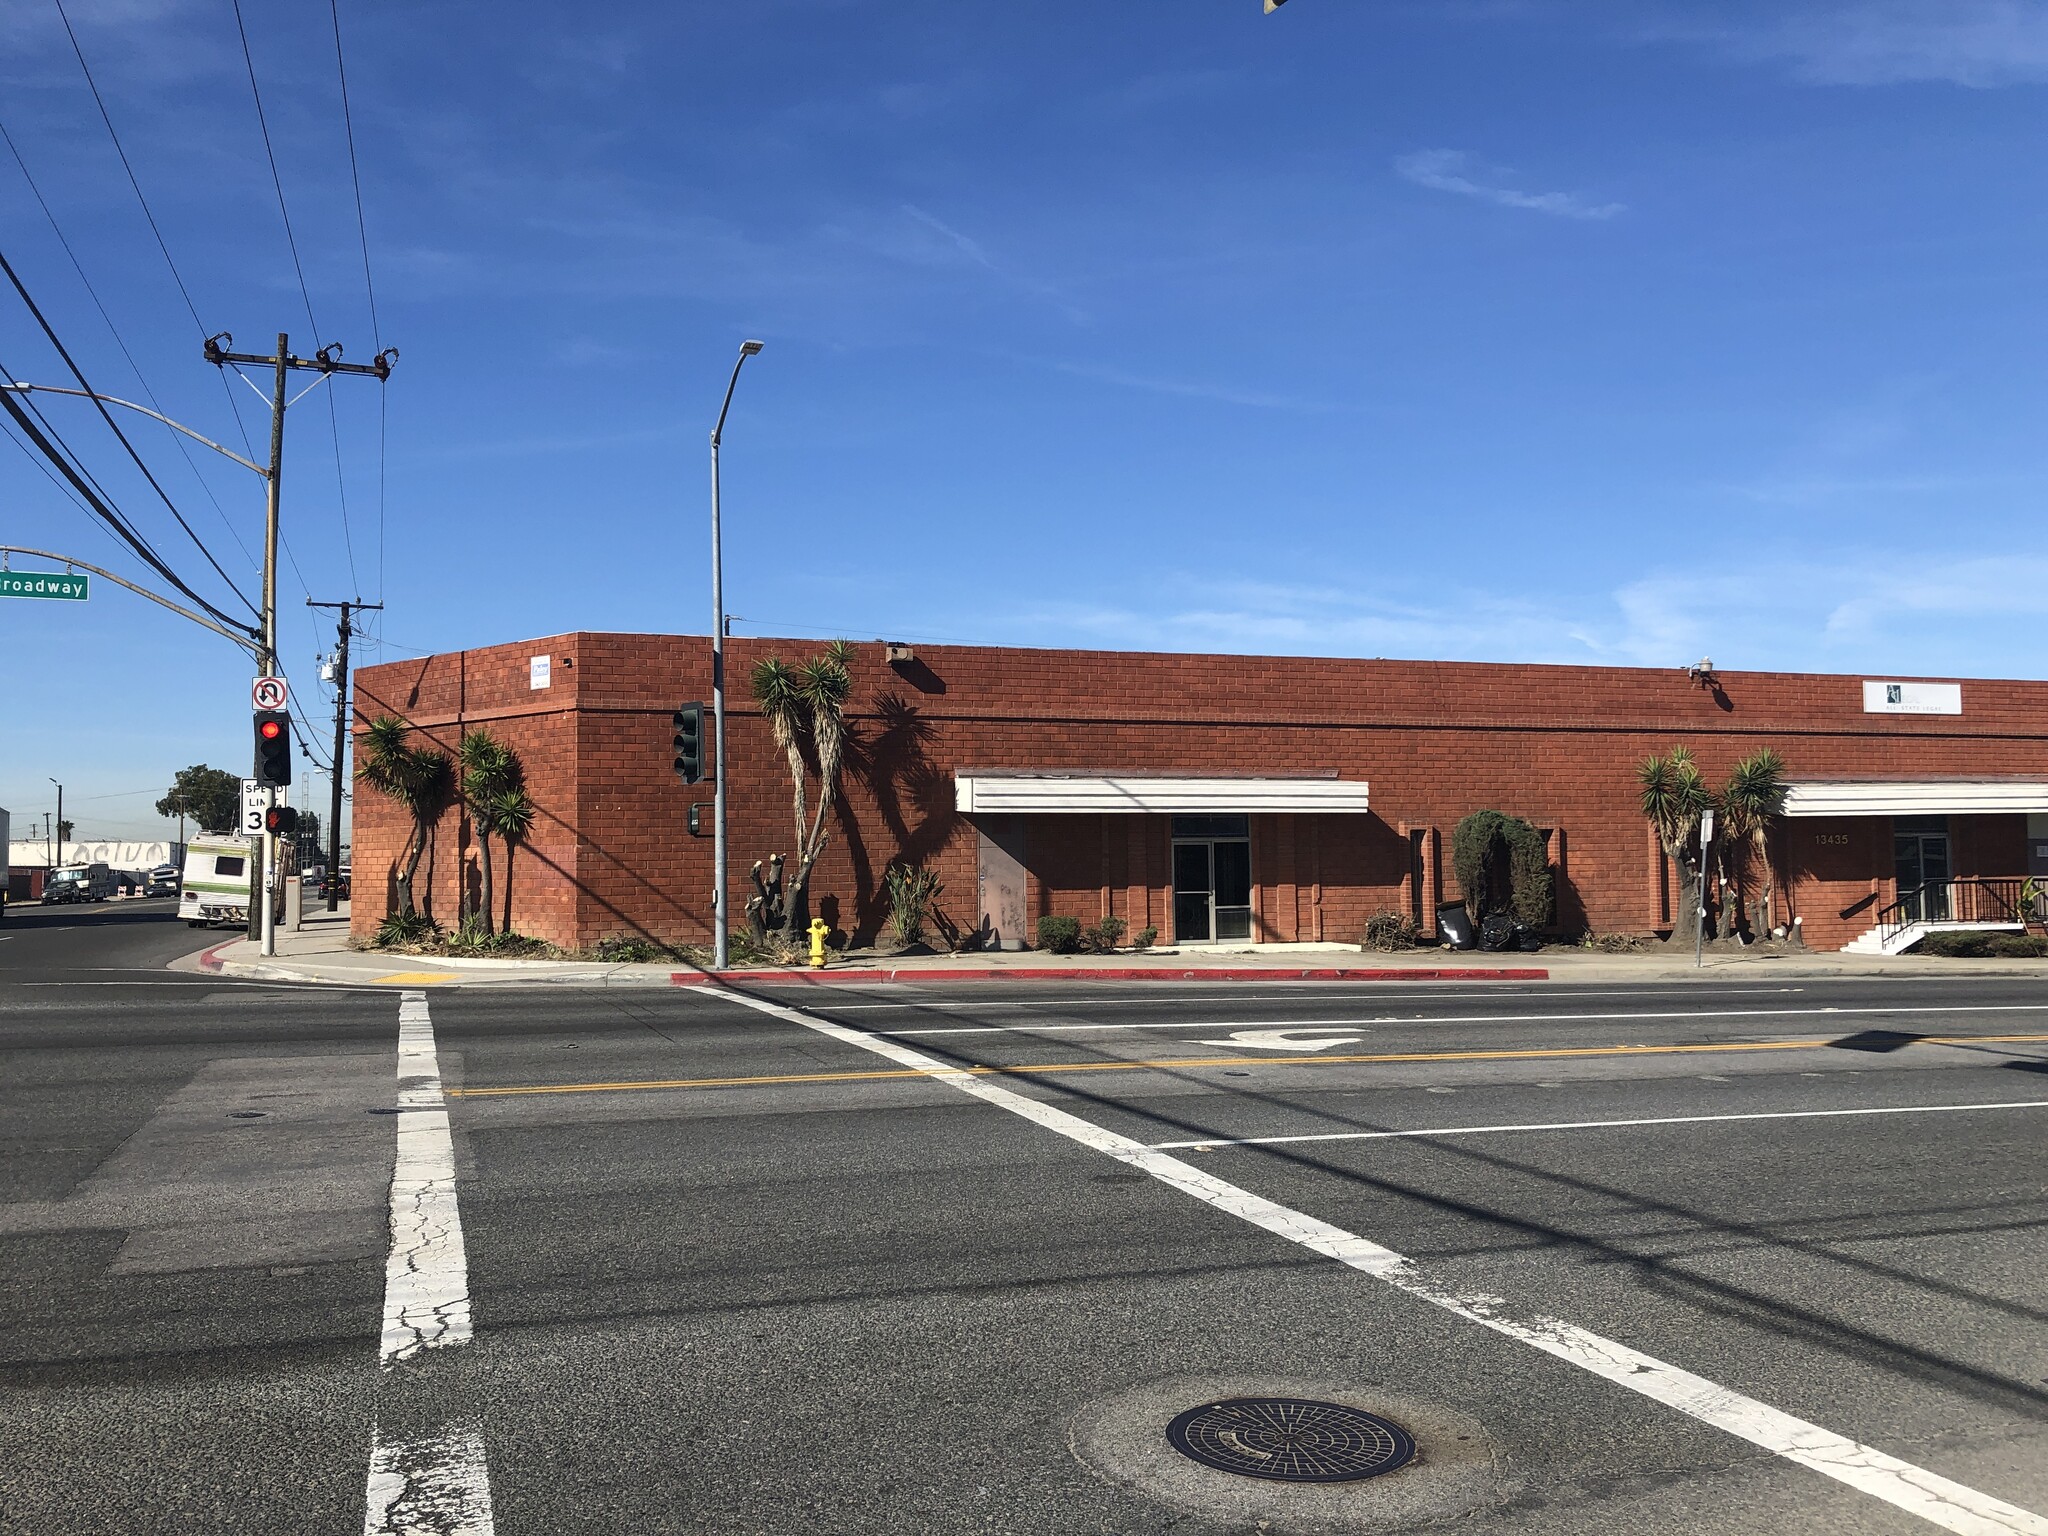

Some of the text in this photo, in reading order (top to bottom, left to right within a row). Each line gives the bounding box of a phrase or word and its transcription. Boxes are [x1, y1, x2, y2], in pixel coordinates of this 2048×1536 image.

[0, 578, 83, 598] roadway
[245, 784, 284, 794] SPED
[1815, 834, 1849, 845] 13435
